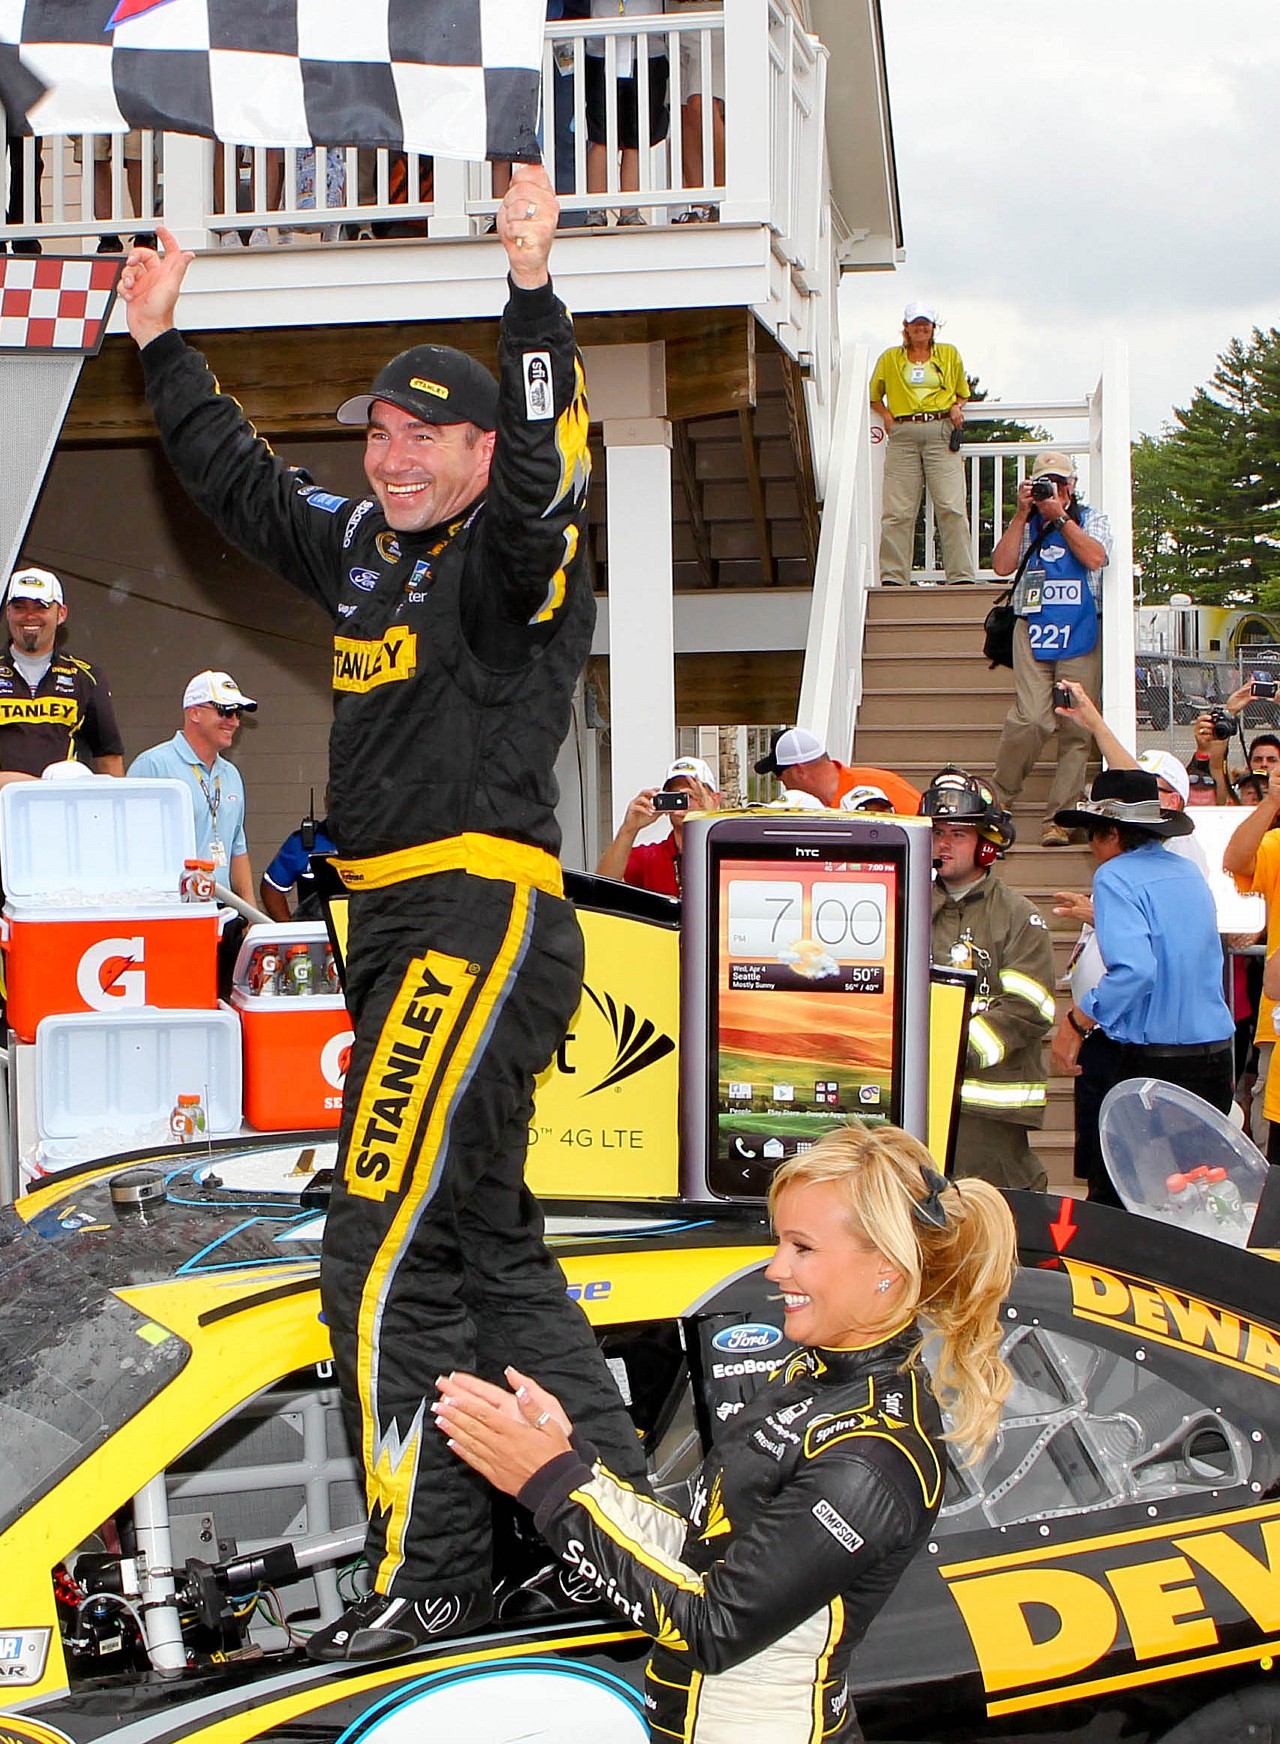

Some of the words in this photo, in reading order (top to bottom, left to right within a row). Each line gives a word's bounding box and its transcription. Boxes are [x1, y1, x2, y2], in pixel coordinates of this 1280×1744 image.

[414, 380, 447, 396] STANLEY
[342, 499, 374, 549] sparco
[1028, 624, 1071, 649] 221
[795, 847, 820, 857] htc
[868, 864, 883, 872] 7:00
[765, 897, 794, 943] 7
[815, 899, 883, 946] 00
[733, 934, 747, 943] PM
[77, 936, 145, 1011] G
[732, 972, 761, 981] Seattle
[749, 966, 761, 974] Apr
[732, 981, 755, 990] Mostly
[755, 982, 775, 990] Sunny
[355, 967, 454, 1183] STANLEY
[729, 1107, 752, 1116] People
[560, 1129, 593, 1148] 4G
[602, 1129, 644, 1149] LTE
[727, 1327, 769, 1348] Ford
[815, 1416, 857, 1443] Sprint
[815, 1503, 861, 1550] SIMPSON
[562, 1539, 646, 1627] Sprint
